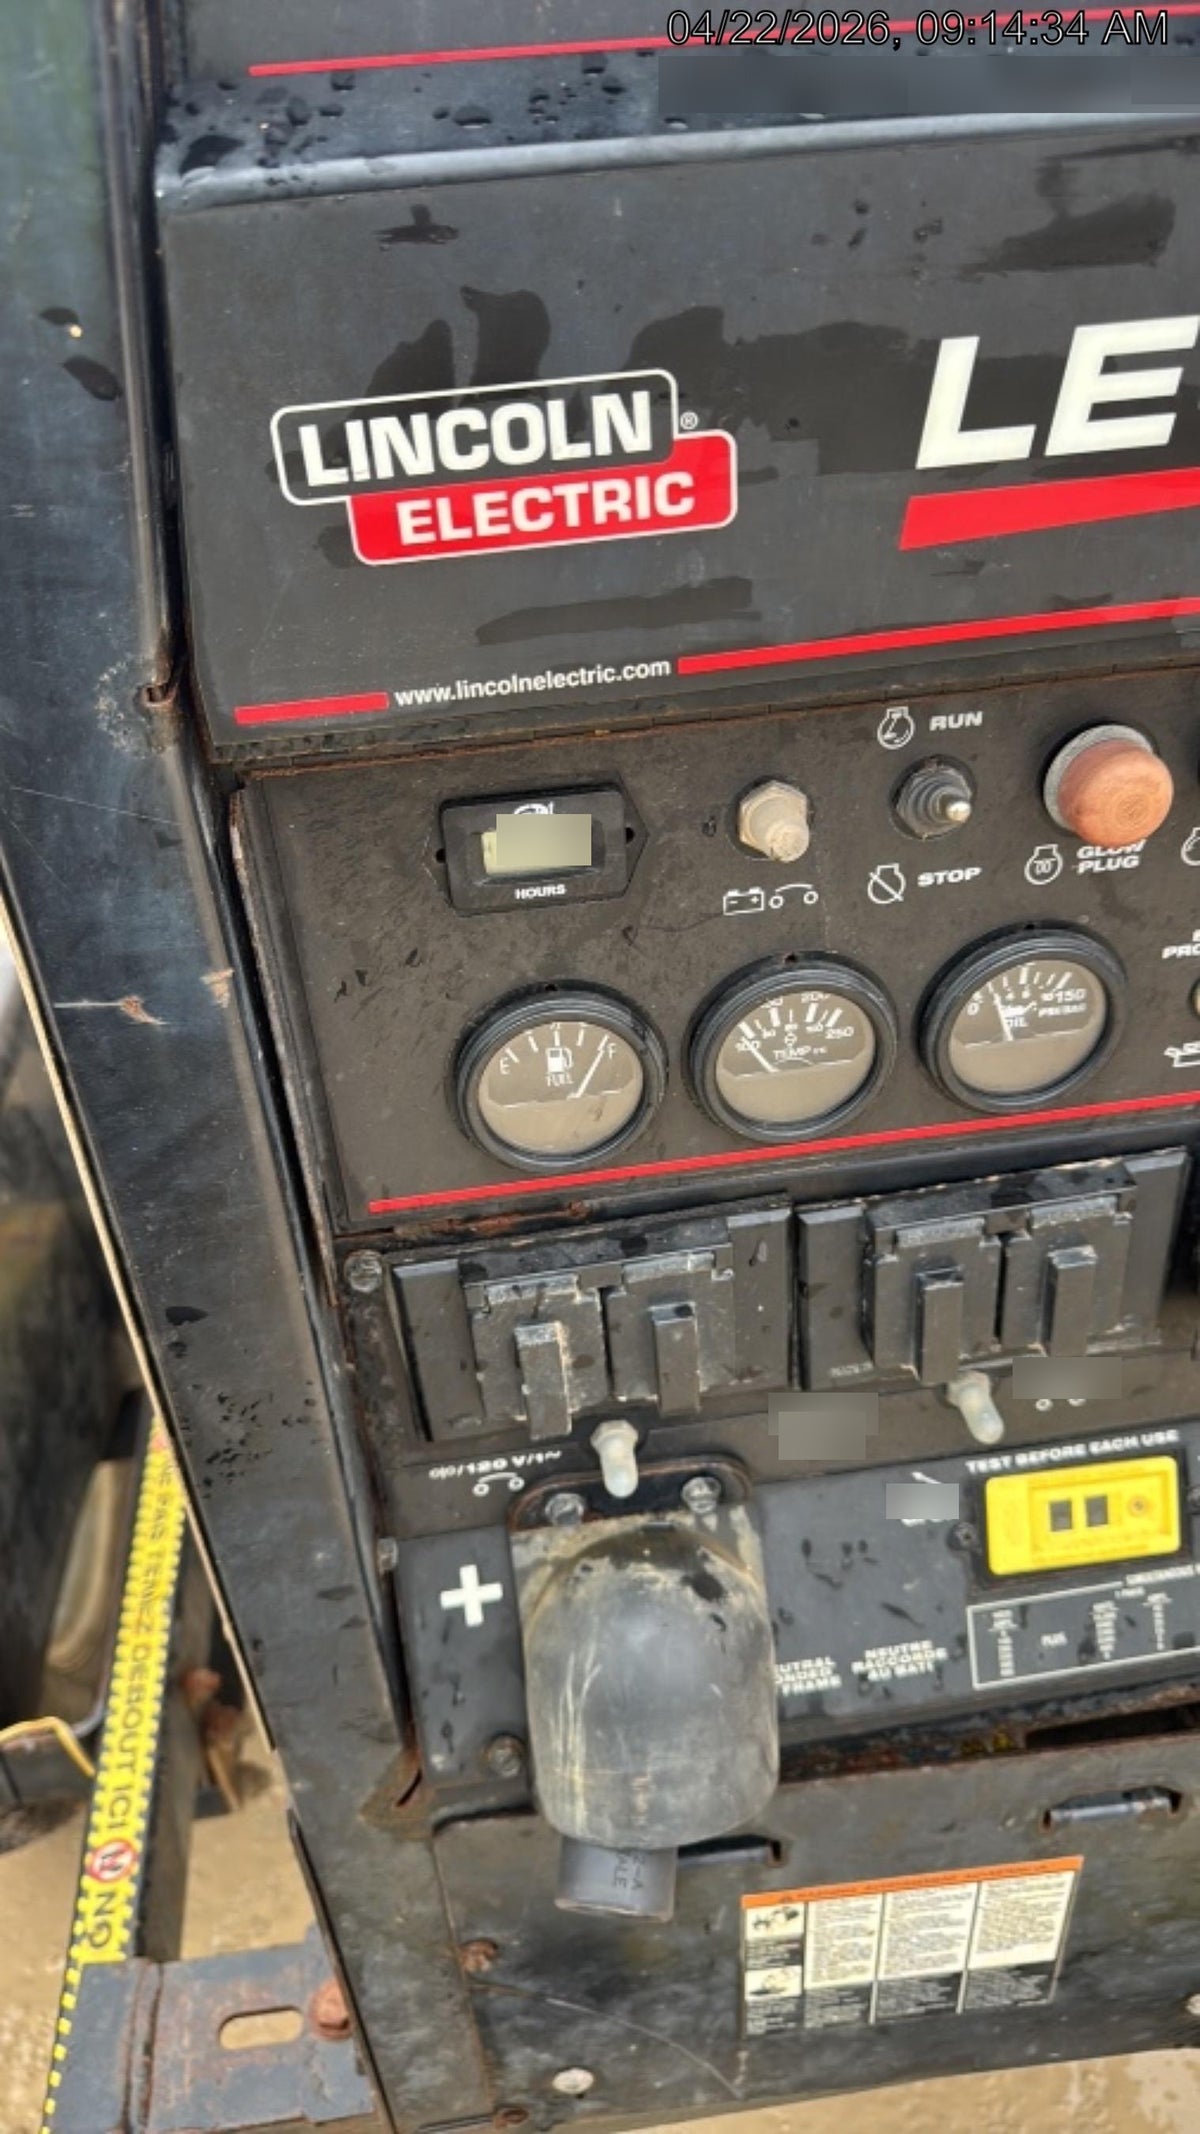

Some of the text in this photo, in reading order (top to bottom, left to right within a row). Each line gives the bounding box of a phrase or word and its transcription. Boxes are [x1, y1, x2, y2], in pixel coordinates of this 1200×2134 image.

[298, 390, 654, 487] LINCOLN
[397, 470, 696, 546] ELECTRIC
[394, 659, 671, 707] www.lincolnelectric.com
[928, 711, 984, 731] RUN
[916, 866, 982, 888] STOP
[1076, 855, 1140, 875] PLUG
[514, 884, 567, 900] HOURS
[500, 1057, 510, 1075] E
[965, 1429, 1180, 1474] TEST BEFORE EACH USE
[775, 1654, 837, 1674] UTRAL
[116, 1643, 150, 1775] DEBOUT
[107, 1785, 133, 1829] ICI
